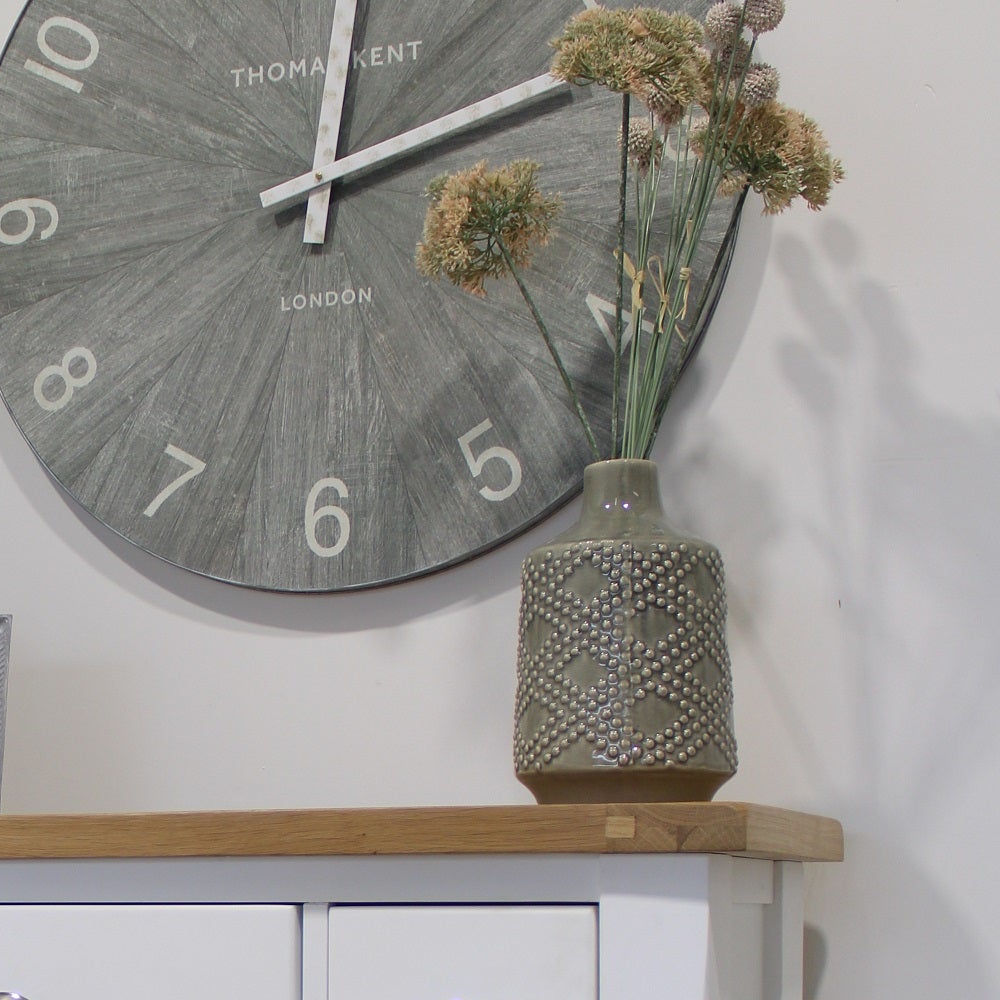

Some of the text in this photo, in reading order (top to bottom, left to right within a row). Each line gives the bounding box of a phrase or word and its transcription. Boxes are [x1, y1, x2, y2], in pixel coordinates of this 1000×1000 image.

[24, 16, 100, 93] 10
[230, 40, 423, 87] THOMA KENT
[281, 287, 372, 311] LONDON
[34, 347, 97, 411] 8
[143, 443, 207, 518] 7
[457, 418, 522, 501] 5
[304, 477, 351, 558] 6
